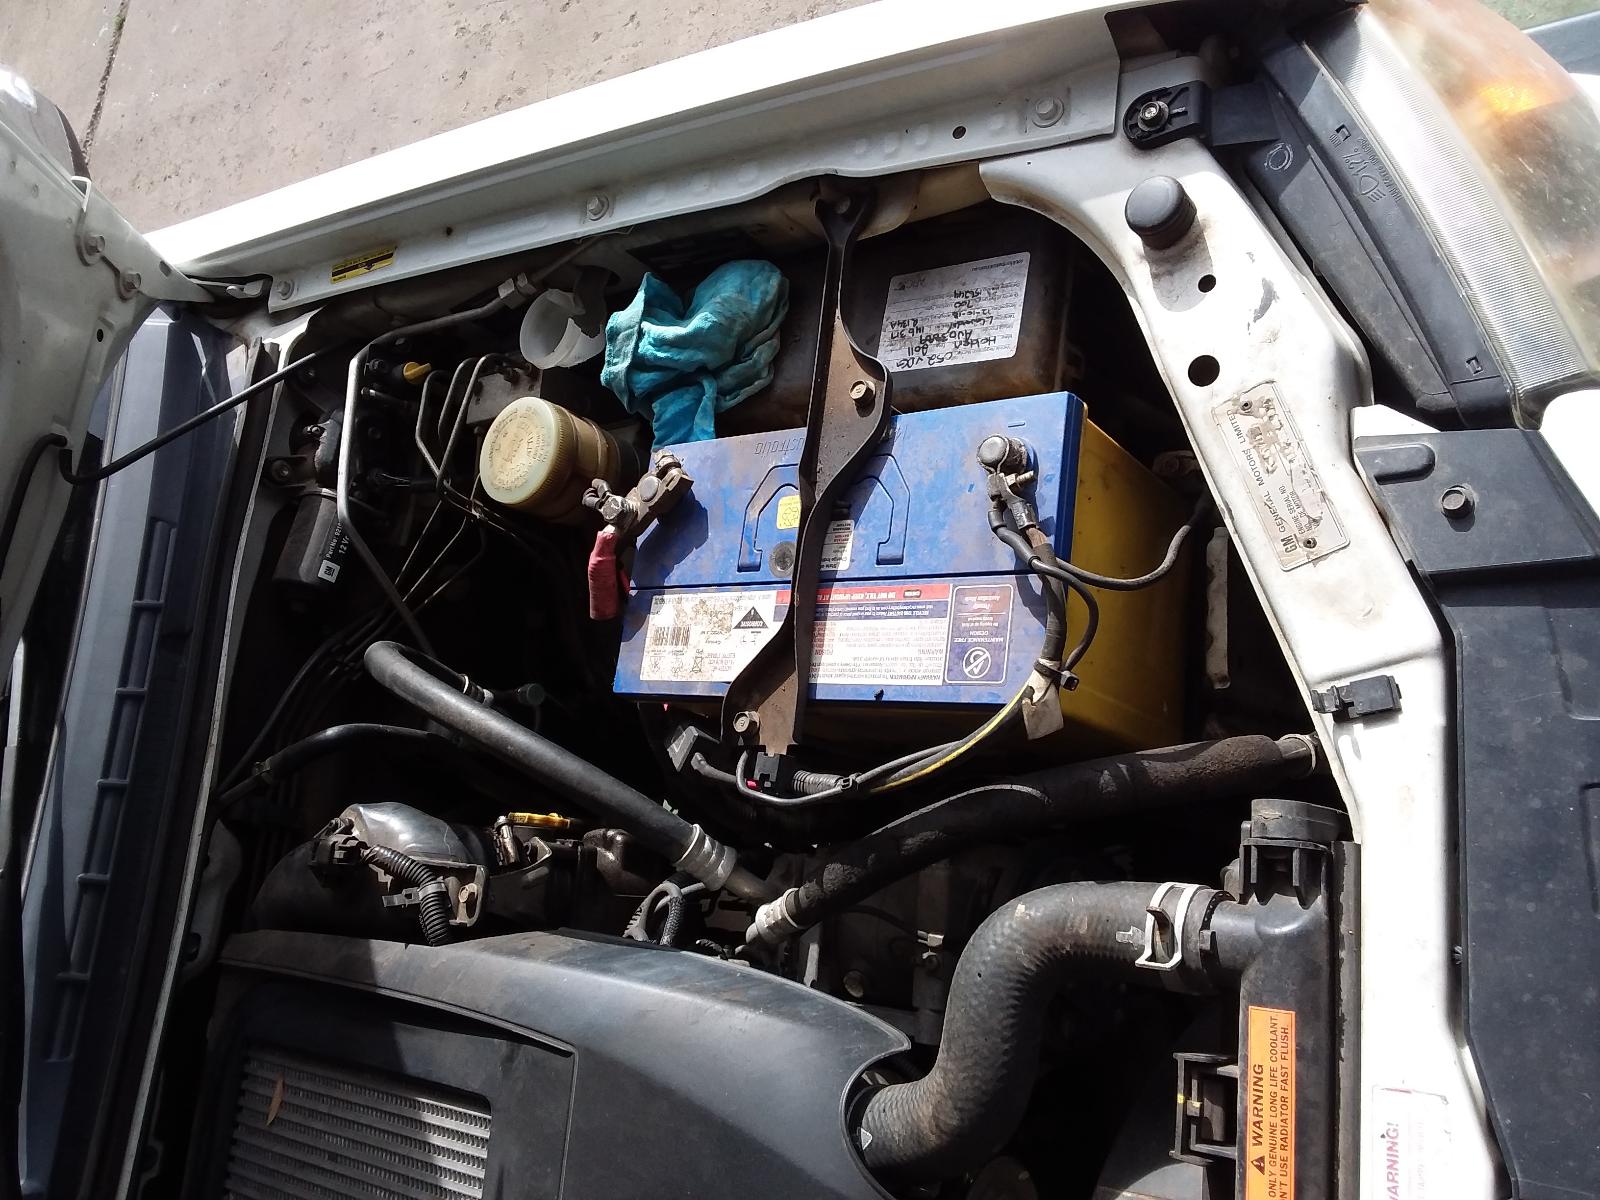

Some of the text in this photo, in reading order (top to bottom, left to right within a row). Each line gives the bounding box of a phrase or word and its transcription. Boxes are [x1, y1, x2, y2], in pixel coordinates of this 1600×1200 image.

[907, 344, 928, 356] 2011
[1227, 409, 1246, 444] LIMITED
[1243, 448, 1265, 486] MOTORS
[1263, 490, 1286, 533] GENERAL
[1280, 534, 1299, 553] GM
[1281, 1025, 1289, 1061] FLUSH.
[1270, 1067, 1278, 1087] LIFE
[1252, 1063, 1264, 1147] WARNING
[1270, 1091, 1278, 1118] LONG
[1280, 1096, 1288, 1151] RADIATOR
[1269, 1122, 1277, 1167] GENUINE
[1280, 1156, 1288, 1177] USE
[1269, 1171, 1277, 1198] ONLY
